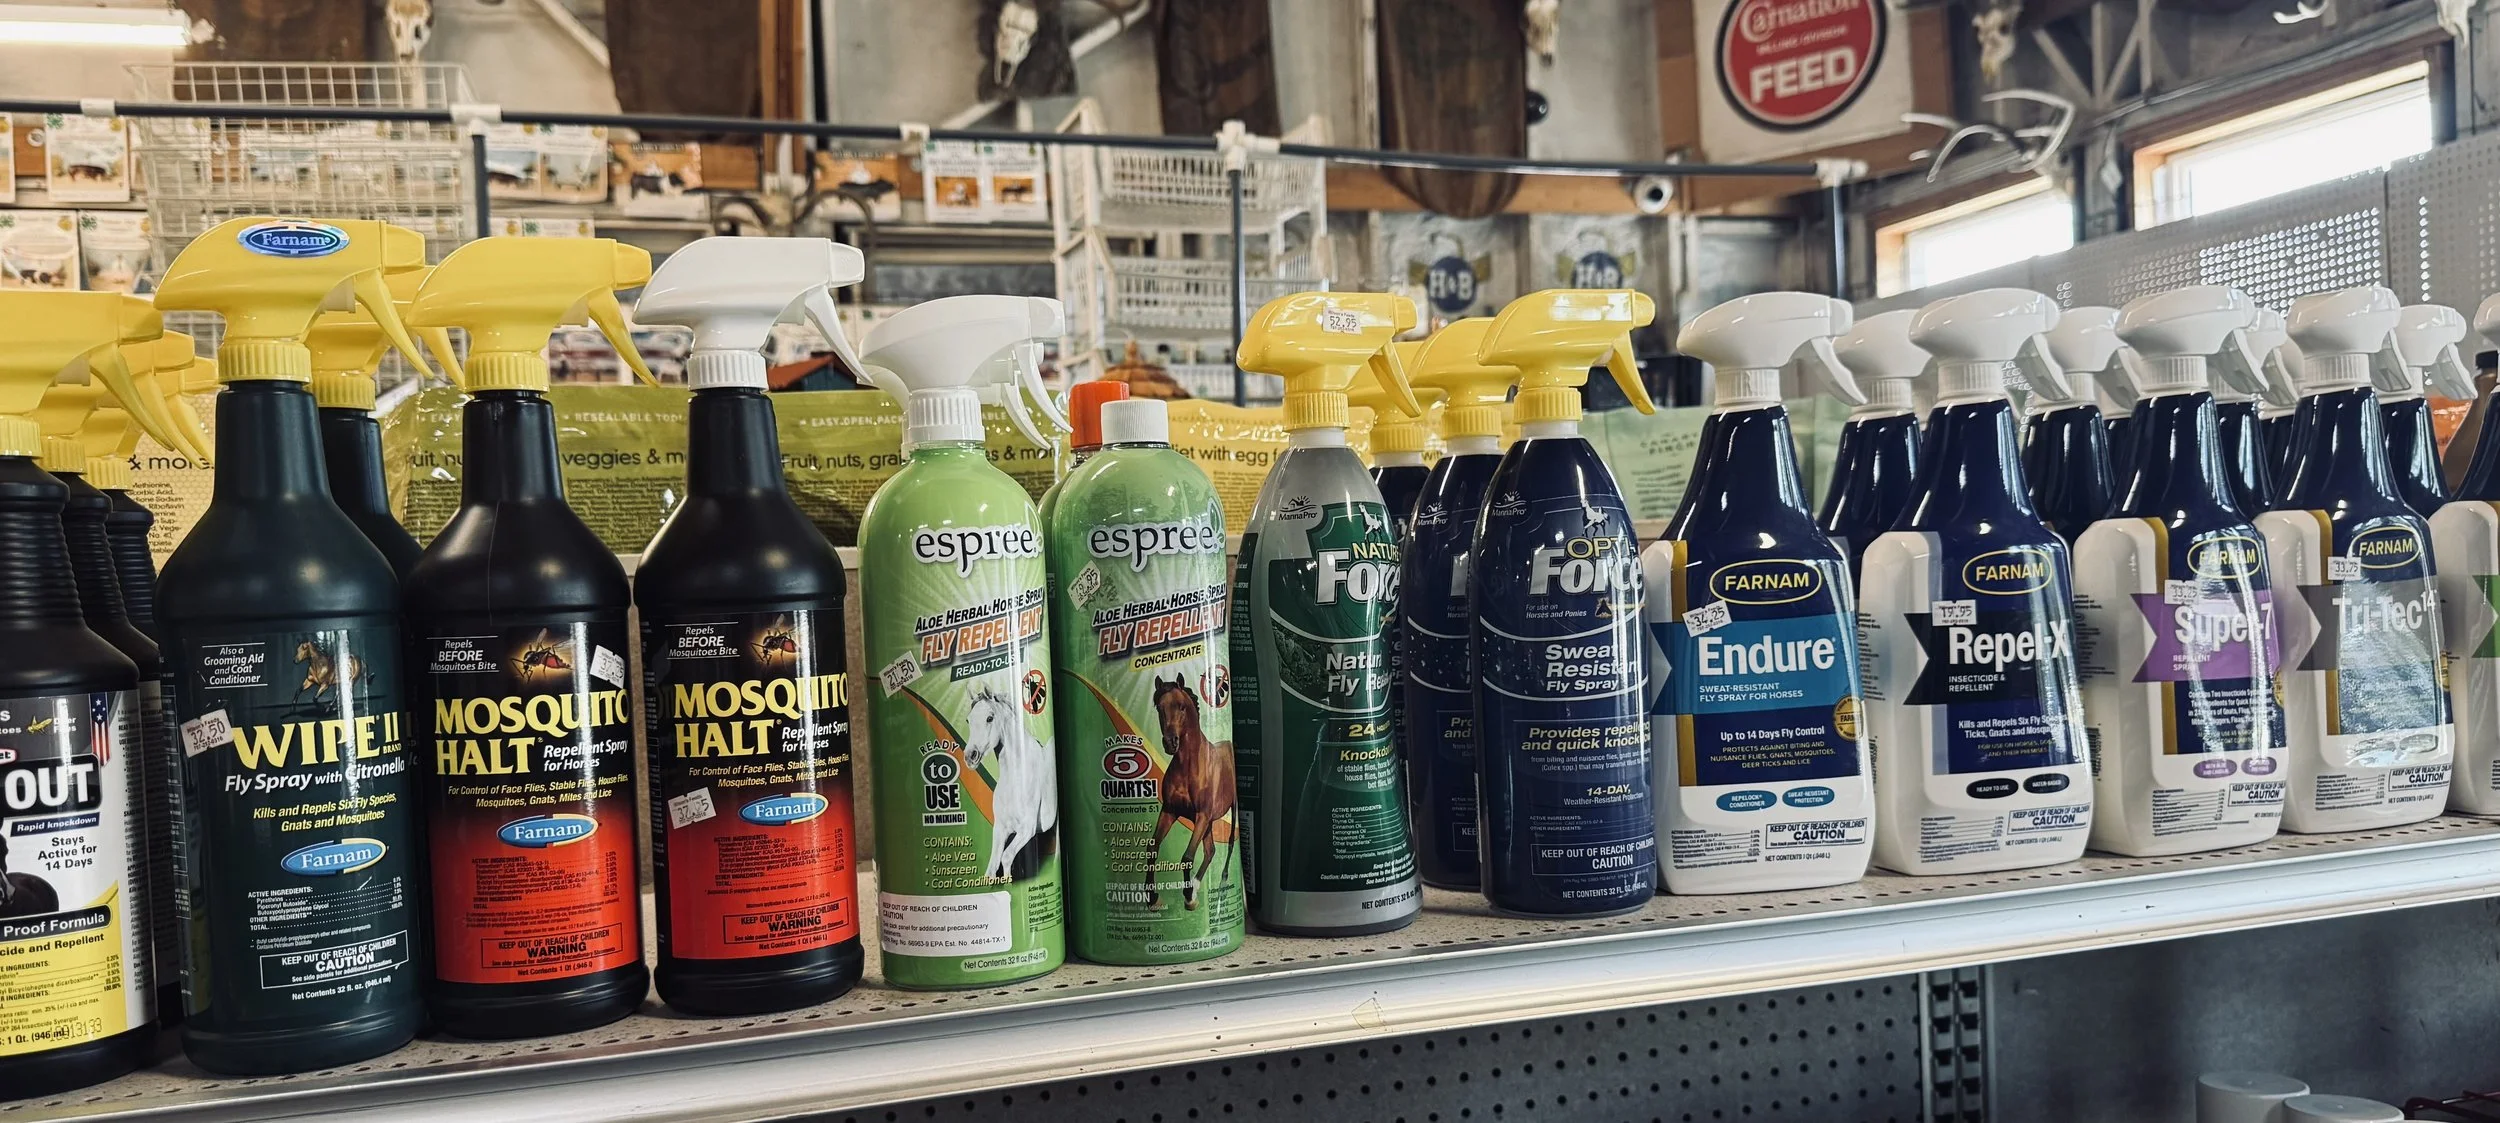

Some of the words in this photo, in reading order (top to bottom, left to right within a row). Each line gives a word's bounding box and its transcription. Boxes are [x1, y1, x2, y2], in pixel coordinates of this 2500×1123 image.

[1749, 46, 1857, 104] FEED
[262, 233, 326, 246] Farnam
[1330, 316, 1357, 328] 52.95
[563, 449, 641, 470] veggies
[647, 448, 661, 464] &
[1200, 445, 1231, 460] with
[1235, 450, 1269, 466] egg
[916, 529, 1033, 573] espree
[1091, 526, 1213, 567] espree
[2359, 538, 2413, 556] FARNAM
[1529, 548, 1643, 595] Force
[1976, 562, 2044, 581] FARNAM
[2335, 561, 2358, 573] 33.75
[1725, 572, 1809, 591] FARNAM
[1093, 608, 1120, 625] ALOE
[1123, 601, 1166, 620] HERBAL
[1171, 590, 1204, 608] HORSE
[1941, 608, 1972, 619] 19.95
[1694, 610, 1725, 629] 34.25
[686, 626, 714, 636] Repels
[1099, 623, 1135, 655] FLY
[444, 640, 473, 650] Repels
[678, 635, 724, 648] BEFORE
[1949, 619, 2070, 673] Repel-X
[220, 647, 236, 655] Also
[438, 650, 483, 661] BEFORE
[669, 648, 718, 658] Mosquitoes
[719, 647, 738, 656] Bite
[1135, 645, 1201, 669] CONCENTRATE
[1545, 644, 1617, 659] Sweat
[1698, 635, 1835, 676] Endure
[204, 656, 246, 666] Grooming
[248, 654, 264, 663] Aid
[430, 662, 476, 672] Mosquitoes
[478, 661, 497, 670] Bite
[215, 666, 229, 675] and
[231, 665, 252, 674] Coat
[887, 660, 915, 687] 21.50
[209, 674, 260, 685] Conditioner
[1327, 675, 1360, 696] Fly
[1546, 680, 1569, 692] Fly
[1574, 679, 1618, 691] Spray
[1948, 675, 1998, 683] INSECTICIDE
[674, 672, 848, 720] MOSQUITO
[1699, 683, 1780, 693] SWEAT-RESISTANT
[1700, 694, 1715, 702] FLY
[1717, 692, 1747, 702] SPRAY
[1749, 691, 1767, 700] FOR
[1769, 690, 1803, 699] HORSES
[1949, 684, 1993, 692] REPELLENT
[435, 689, 630, 738] MOSQUITO
[1349, 723, 1375, 736] 24
[1959, 720, 1975, 729] Kills
[1976, 719, 1991, 728] and
[1992, 717, 2017, 728] Repels
[2018, 717, 2029, 726] Six
[190, 721, 225, 745] 32.50
[232, 717, 380, 770] WIPE
[384, 711, 399, 743] II
[675, 719, 775, 758] HALT
[1106, 735, 1144, 747] MAKES
[1720, 732, 1733, 741] Up
[1734, 731, 1745, 740] to
[1747, 730, 1757, 740] 14
[1758, 729, 1780, 740] Days
[1781, 728, 1794, 739] Fly
[1795, 725, 1825, 737] Control
[1964, 730, 1988, 739] Ticks,
[1989, 728, 2010, 738] Gnats
[2011, 727, 2025, 736] and
[383, 743, 401, 755] BRAND
[436, 737, 536, 775] HALT
[919, 740, 960, 756] READY
[929, 761, 951, 779] to
[1113, 753, 1140, 775] 5
[225, 775, 251, 795] Fly
[255, 772, 313, 793] Spray
[315, 772, 342, 784] with
[345, 756, 405, 781] Citronella
[2408, 773, 2444, 784] CAUTION
[5, 763, 93, 810] OUT
[1101, 780, 1158, 799] QUARTS!
[1587, 784, 1631, 796] 14-DAY,
[475, 797, 527, 808] Mosquitoes,
[529, 795, 557, 805] Gnats,
[559, 793, 582, 803] Mites
[598, 789, 612, 798] Lice
[925, 784, 959, 809] USE
[2248, 790, 2280, 800] CAUTION
[253, 807, 276, 819] Kills
[278, 806, 299, 817] and
[301, 802, 336, 816] Repels
[338, 800, 353, 811] Six
[354, 797, 368, 810] Fly
[369, 793, 397, 806] Species,
[755, 802, 815, 818] Farnam
[1101, 806, 1147, 814] Concentrate
[1148, 805, 1159, 813] 5:1
[17, 822, 45, 832] Rapid
[47, 816, 97, 829] knockdown
[281, 821, 311, 832] Gnats
[314, 817, 333, 828] and
[336, 810, 385, 825] Mosquitoes
[1103, 822, 1153, 834] CONTAINS:
[2032, 814, 2076, 826] CAUTION
[515, 823, 582, 840] Farnam
[1793, 829, 1845, 841] CAUTION
[52, 835, 84, 847] Stays
[923, 837, 972, 848] CONTAINS:
[1111, 837, 1131, 847] Aloe
[1133, 838, 1156, 846] Vera
[38, 848, 77, 860] Active
[82, 844, 97, 854] for
[301, 848, 373, 869] Farnam
[932, 852, 952, 862] Aloe
[954, 852, 976, 862] Vera
[1111, 850, 1158, 860] Sunscreen
[45, 861, 61, 871] 14
[65, 857, 93, 870] Days
[932, 865, 978, 876] Sunscreen
[1111, 862, 1135, 872] Coat
[1136, 860, 1193, 872] Conditioners
[1592, 855, 1633, 870] CAUTION
[932, 878, 953, 889] Coat
[955, 874, 1013, 888] Conditioners
[1106, 892, 1151, 903] CAUTION
[4, 921, 46, 937] Proof
[50, 913, 105, 931] Formula
[768, 915, 822, 932] WARNING
[29, 942, 51, 953] and
[54, 934, 105, 950] Repellent
[527, 942, 587, 958] WARNING
[282, 957, 302, 966] KEEP
[304, 954, 319, 964] OUT
[321, 953, 332, 962] OF
[333, 947, 357, 959] REACH
[358, 945, 367, 955] OF
[368, 938, 397, 952] CHILDREN
[315, 952, 375, 973] CAUTION
